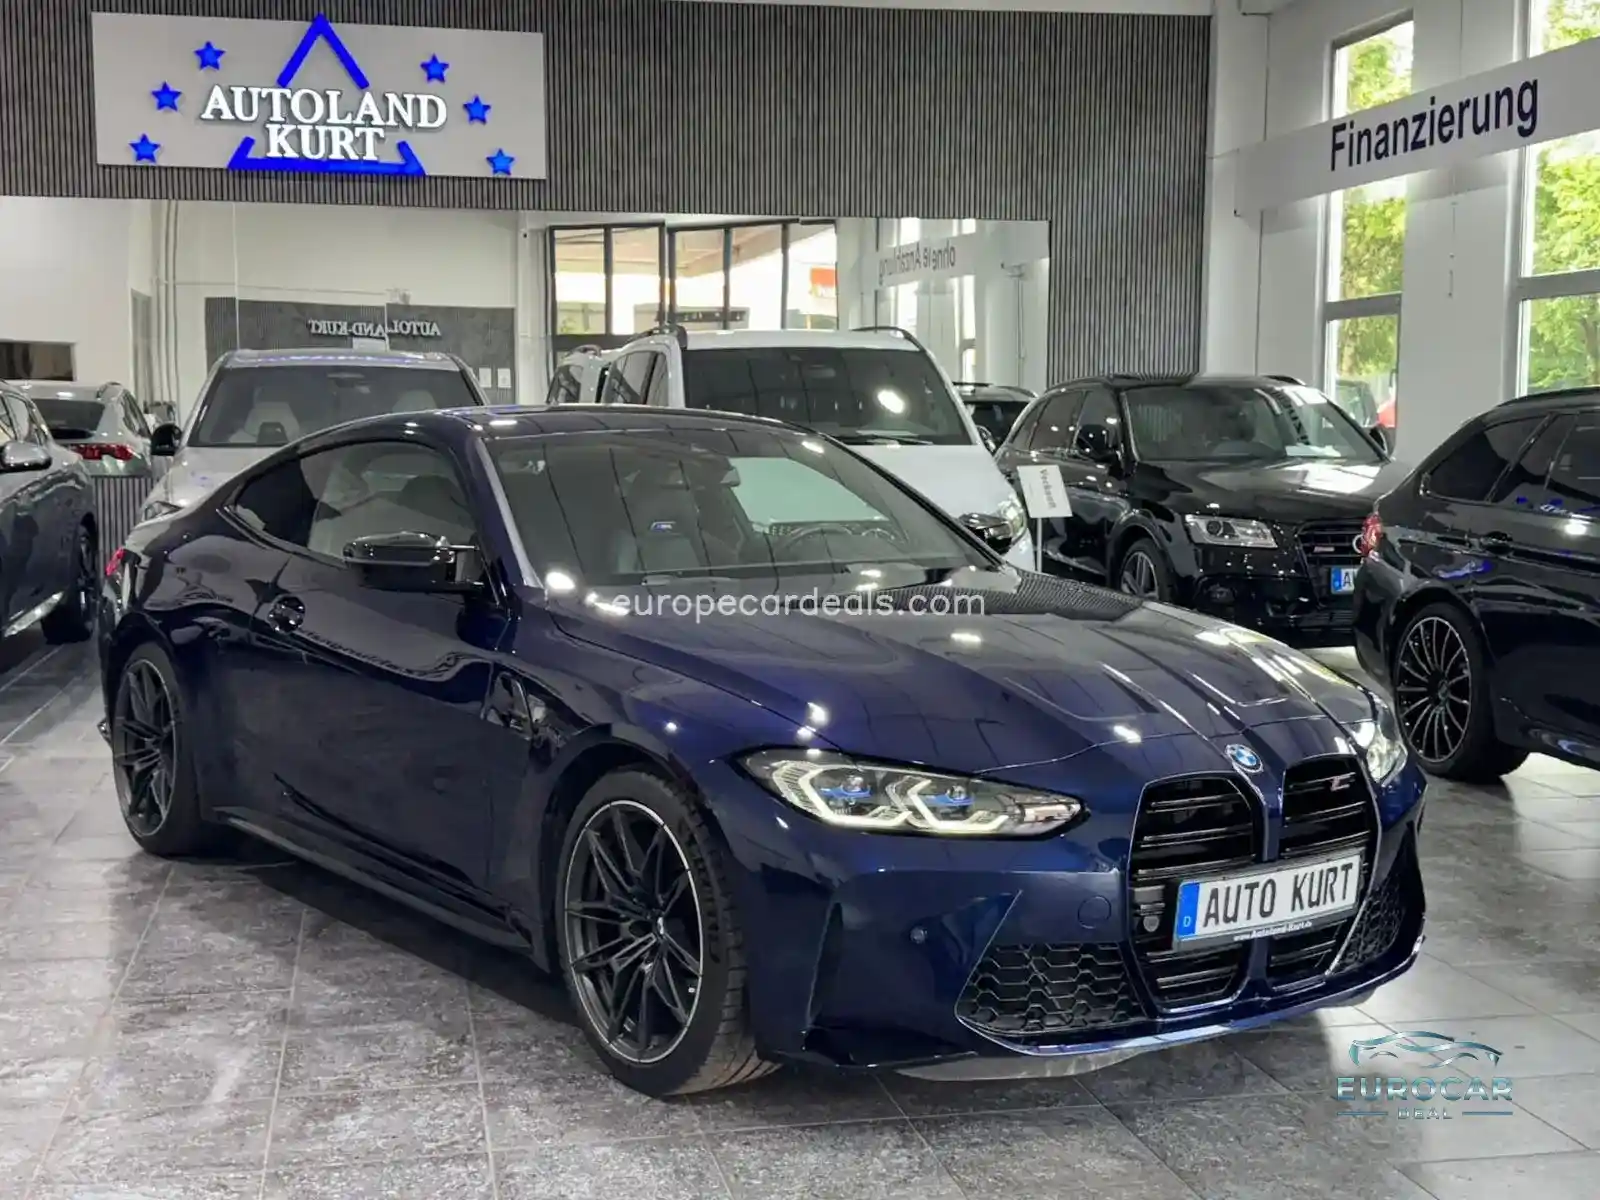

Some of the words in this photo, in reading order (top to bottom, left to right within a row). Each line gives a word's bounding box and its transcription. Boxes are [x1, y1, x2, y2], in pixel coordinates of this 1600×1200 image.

[200, 84, 448, 129] AUTOLAND
[1331, 79, 1538, 171] Finanzierung
[266, 123, 385, 161] KURT
[1203, 878, 1277, 928] AUTO
[1290, 862, 1354, 913] KURT
